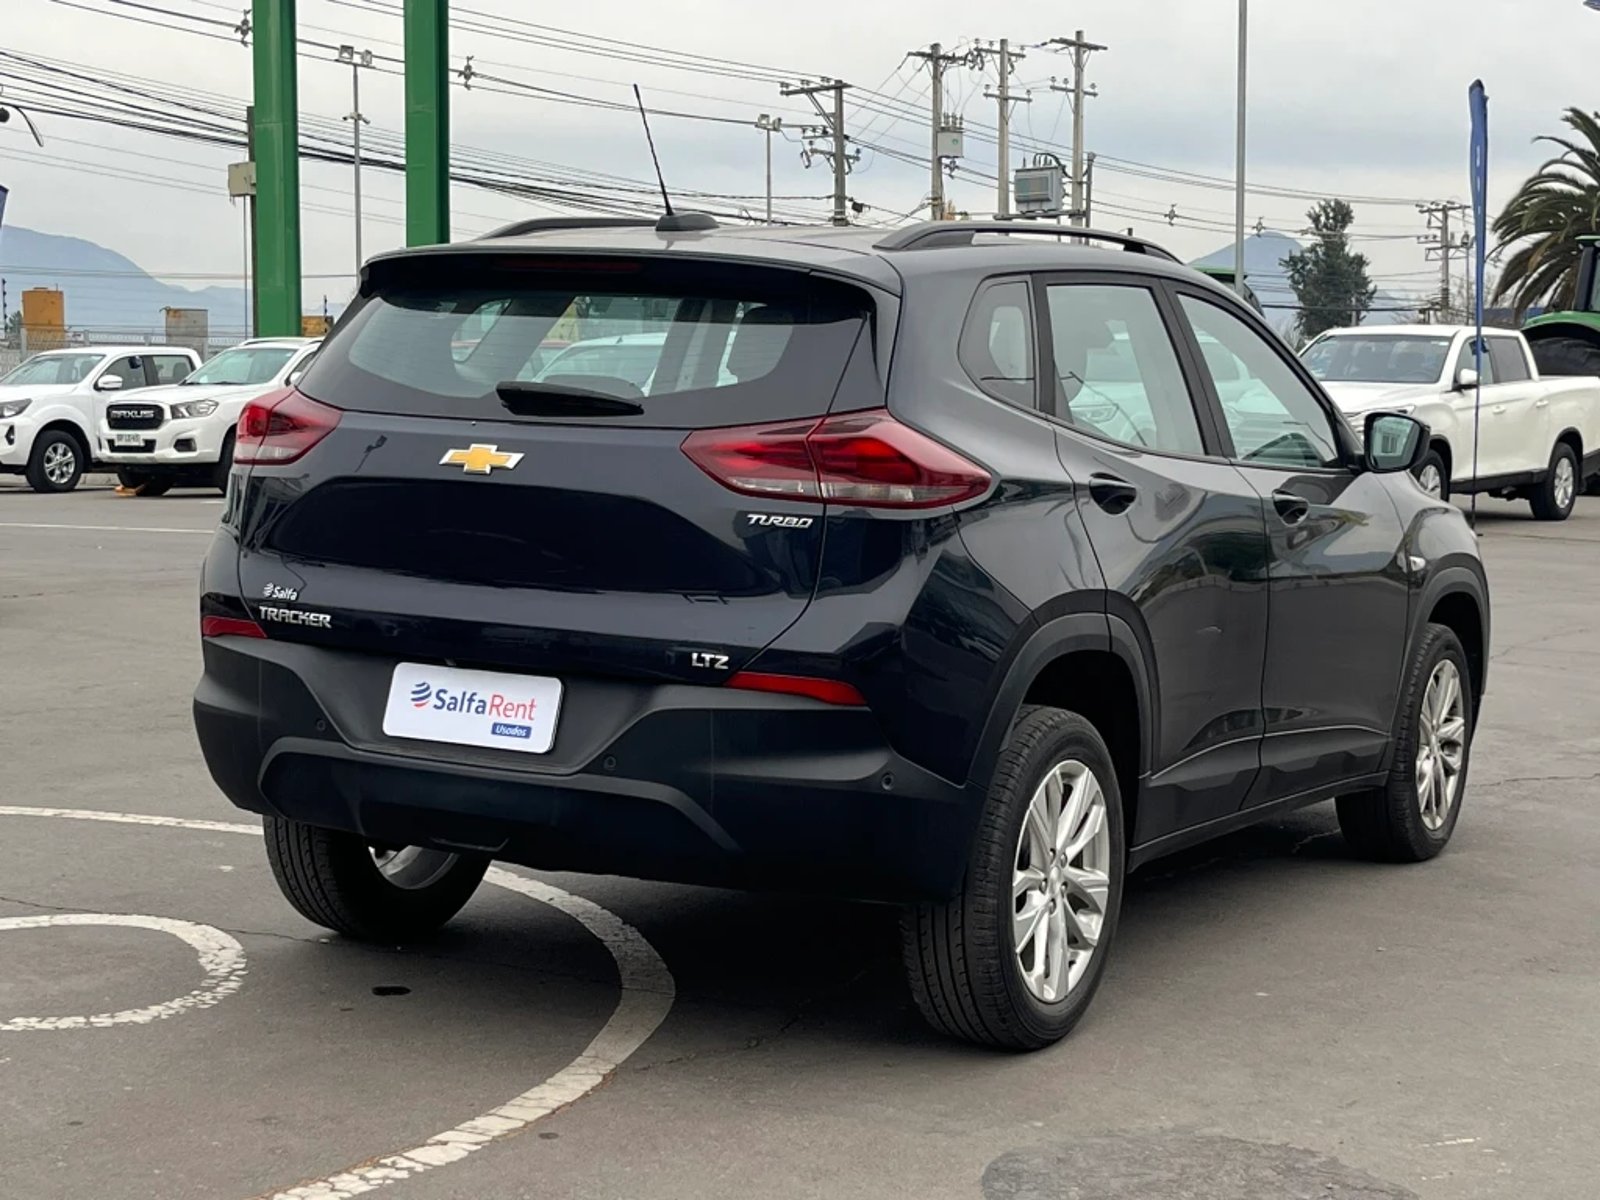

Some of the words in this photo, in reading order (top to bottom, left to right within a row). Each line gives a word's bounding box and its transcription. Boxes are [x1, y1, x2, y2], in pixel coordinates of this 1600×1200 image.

[747, 513, 813, 528] TURBO
[272, 586, 298, 601] Salfa
[259, 605, 332, 629] TRACKER
[691, 652, 729, 670] LTZ
[433, 688, 537, 721] SalfaRent
[495, 724, 528, 737] Usados
